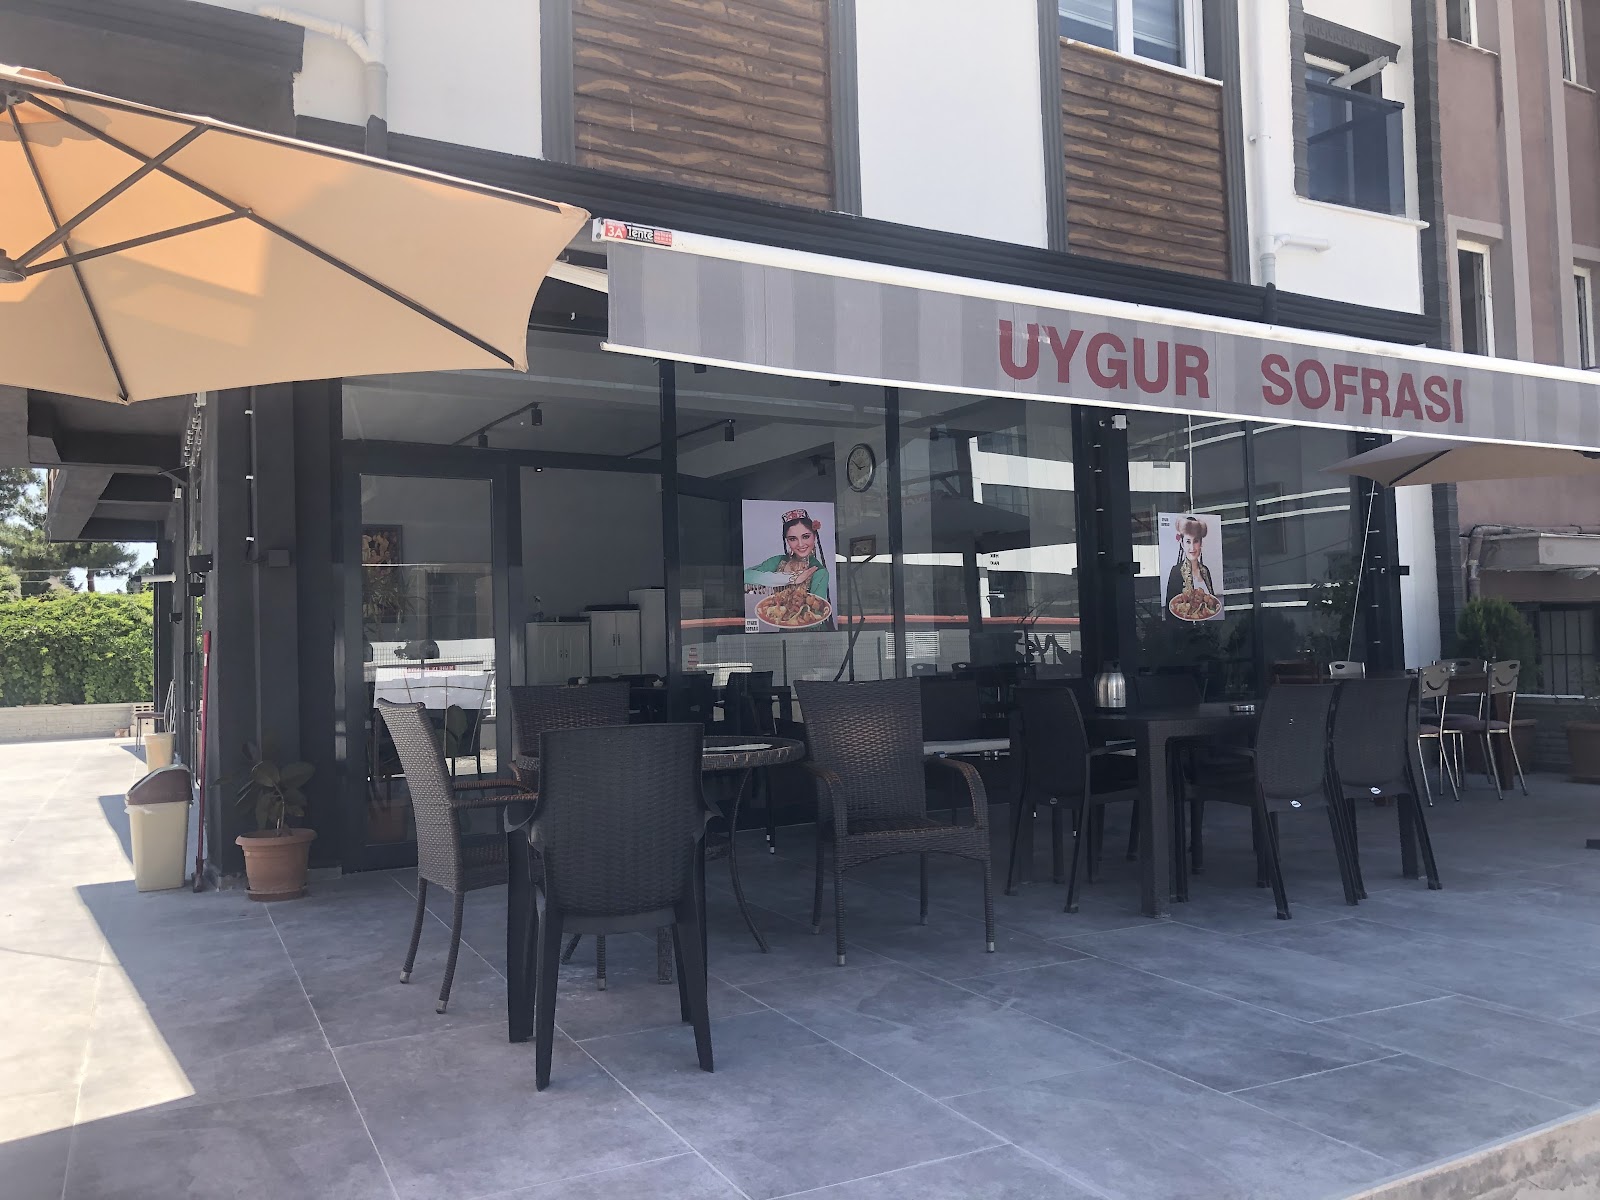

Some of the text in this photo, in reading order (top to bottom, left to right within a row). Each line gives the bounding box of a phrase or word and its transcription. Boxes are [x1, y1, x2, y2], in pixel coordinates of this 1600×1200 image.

[607, 225, 623, 239] 3A
[627, 225, 654, 241] Tente
[998, 319, 1464, 424] UYGUR SOFRASI
